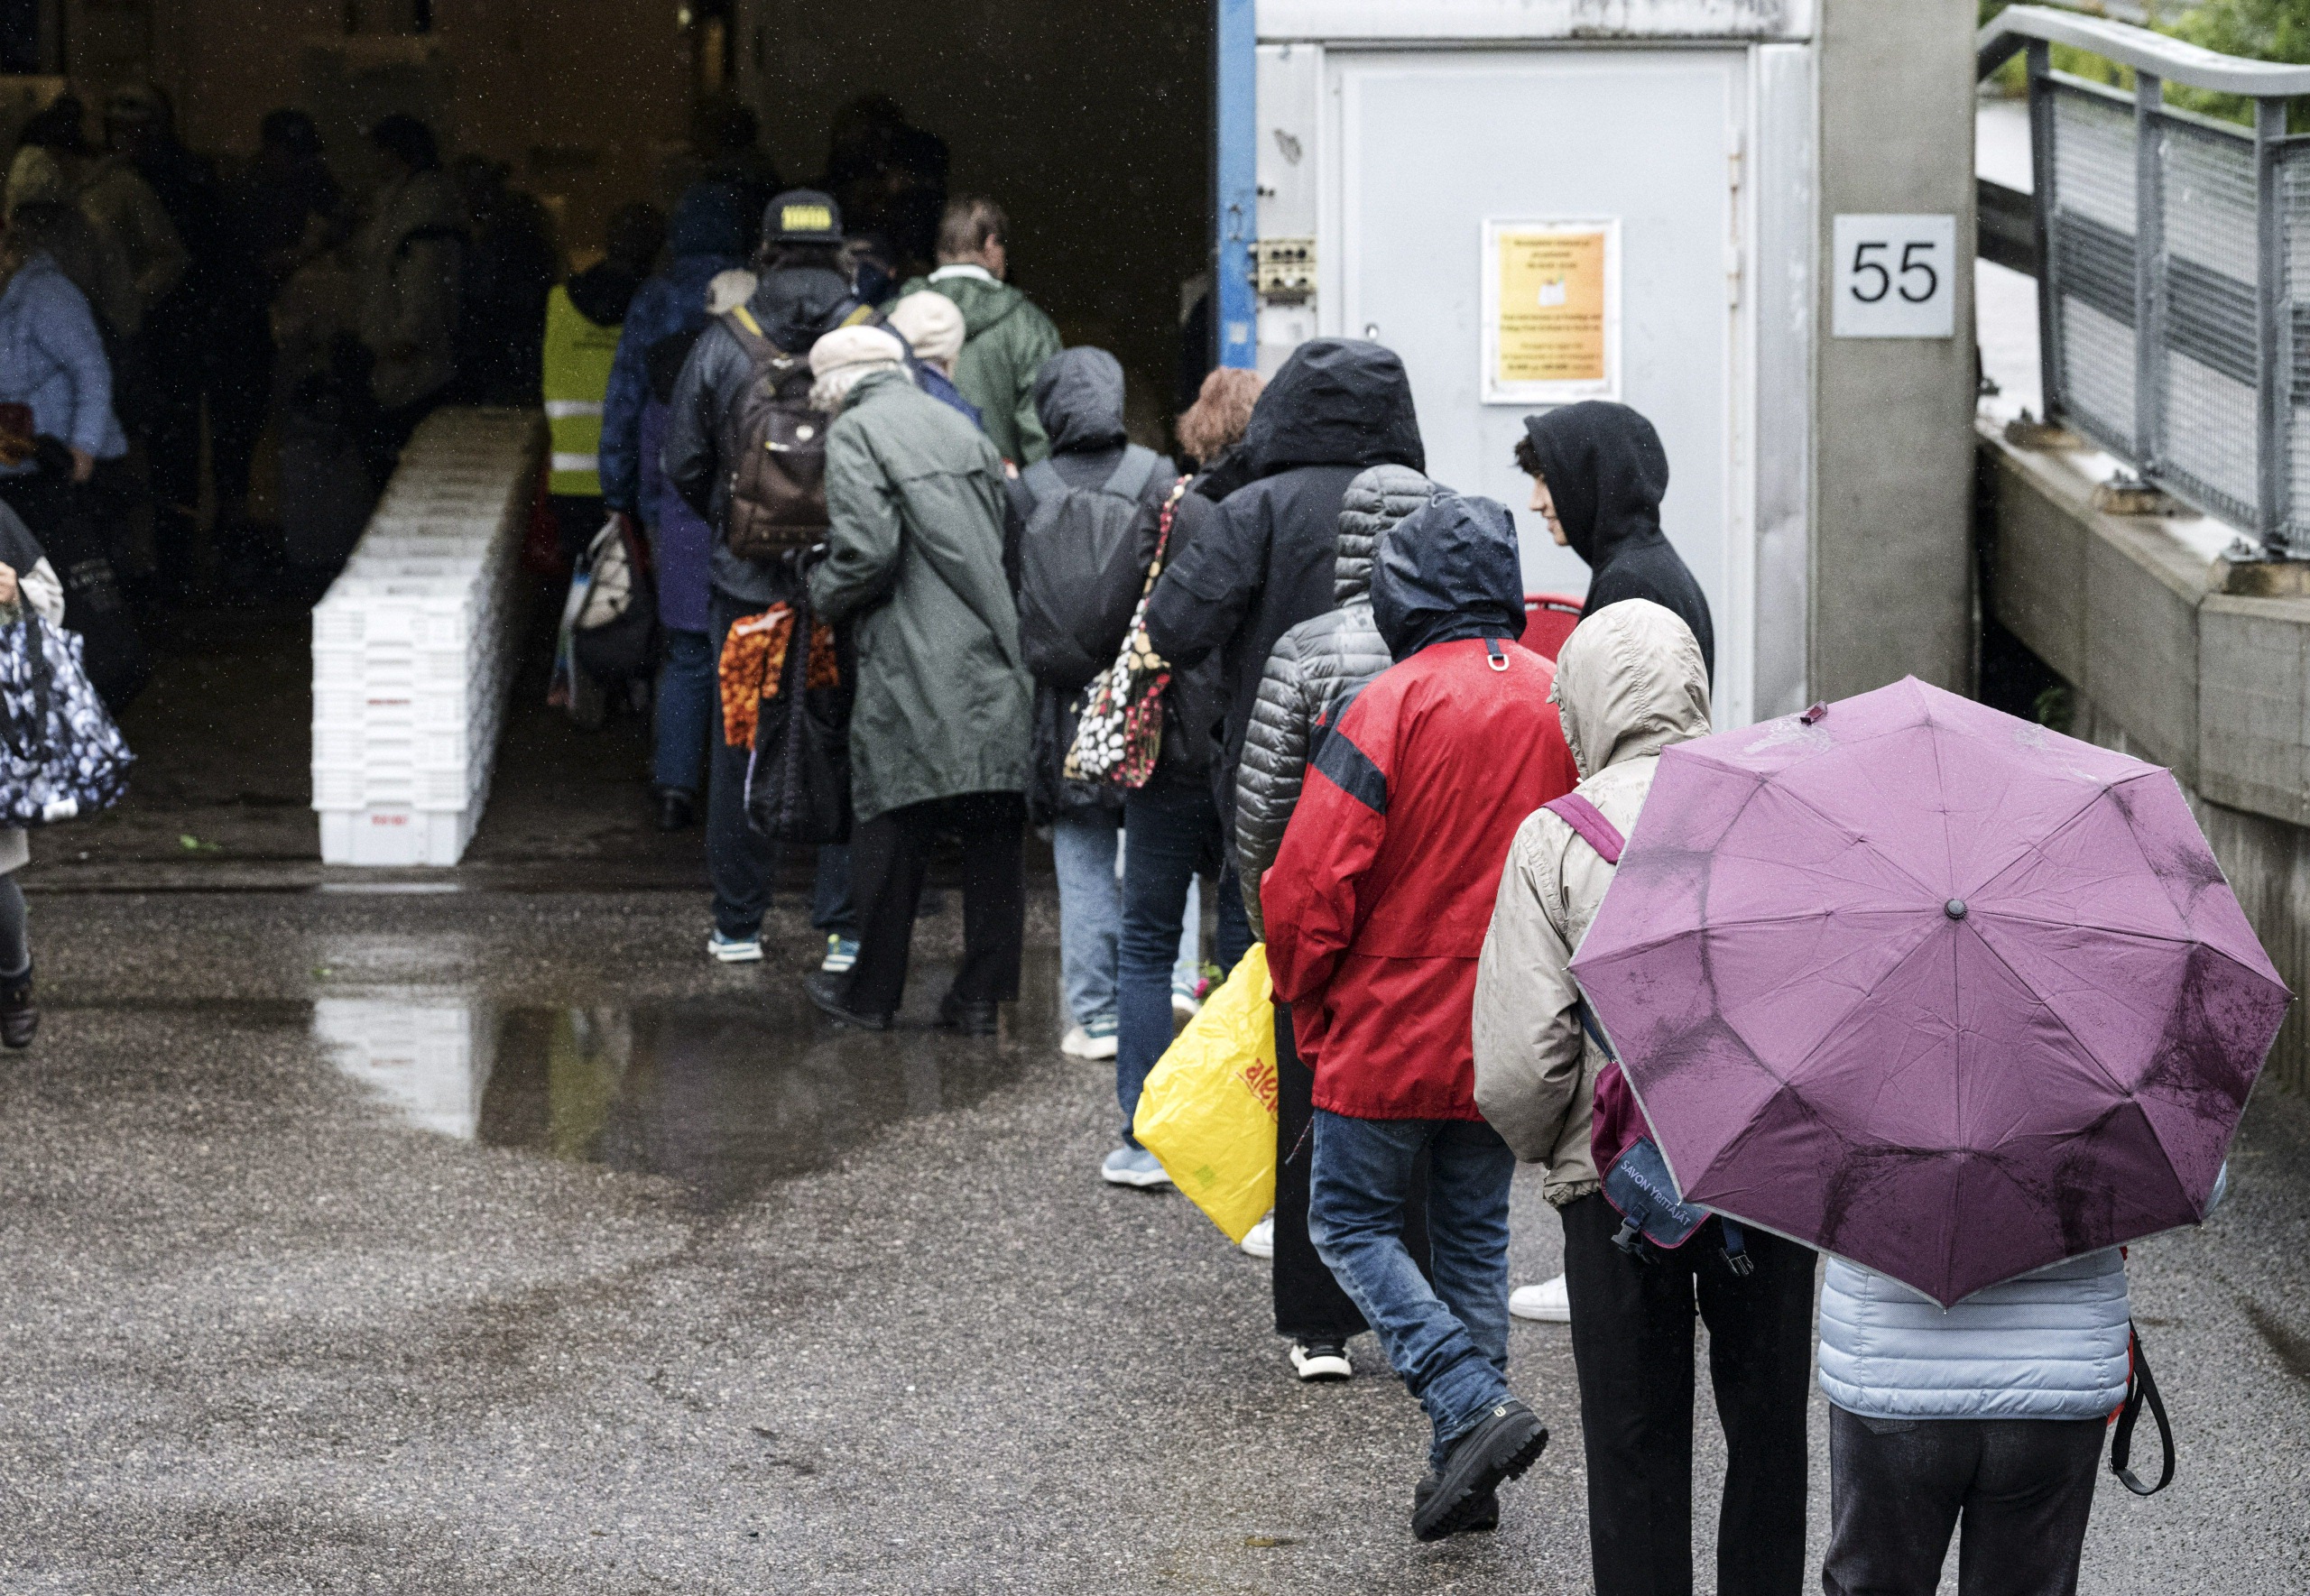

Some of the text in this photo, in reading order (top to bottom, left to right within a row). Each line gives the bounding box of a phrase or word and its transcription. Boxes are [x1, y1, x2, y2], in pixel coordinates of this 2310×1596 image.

[1851, 242, 1937, 303] 55
[1621, 1159, 1691, 1226] SAVON YRITTÄJÄT
